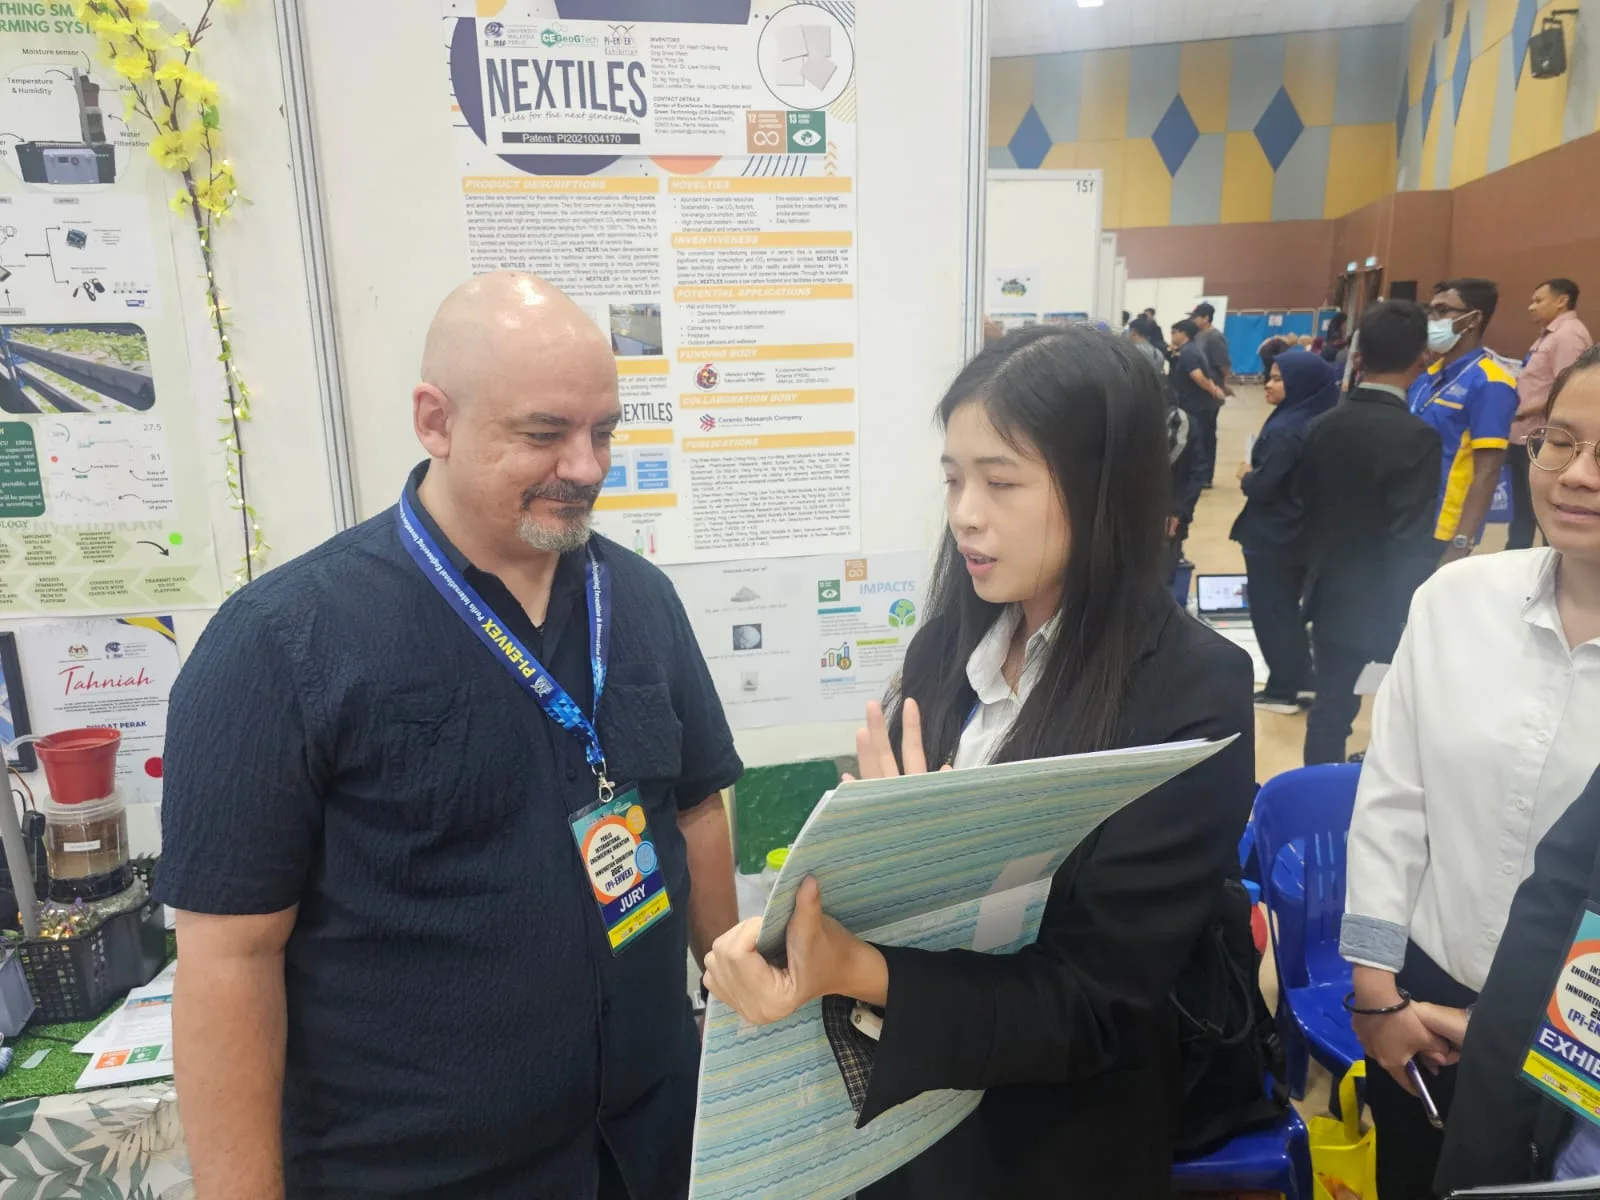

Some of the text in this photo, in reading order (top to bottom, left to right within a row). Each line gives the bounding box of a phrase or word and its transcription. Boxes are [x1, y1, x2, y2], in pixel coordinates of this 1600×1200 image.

[50, 4, 75, 16] SM
[8, 78, 54, 86] Temperature
[486, 58, 647, 118] NEXTILES
[529, 112, 541, 122] for
[748, 114, 757, 123] 12
[789, 114, 797, 124] 13
[522, 134, 621, 143] Patent: PI2021004170
[465, 180, 520, 189] PRODUCT
[671, 180, 729, 189] NOVELTIES
[674, 236, 759, 244] INVENTIVENESS
[738, 288, 810, 296] APPLICATIONS
[683, 394, 798, 405] COLLABORATION BODY
[620, 403, 673, 423] EXTILES
[686, 439, 759, 448] PUBLICATIONS
[440, 569, 472, 610] International
[860, 581, 915, 594] IMPACTS
[468, 605, 486, 622] Perlis
[482, 618, 536, 678] PI-ENVEX
[58, 666, 156, 696] Tahniah
[595, 835, 621, 853] INTERNATIONAL
[612, 837, 630, 852] INVENTION
[595, 861, 616, 877] INNOVATION
[611, 864, 624, 877] 2024
[620, 884, 646, 913] JURY
